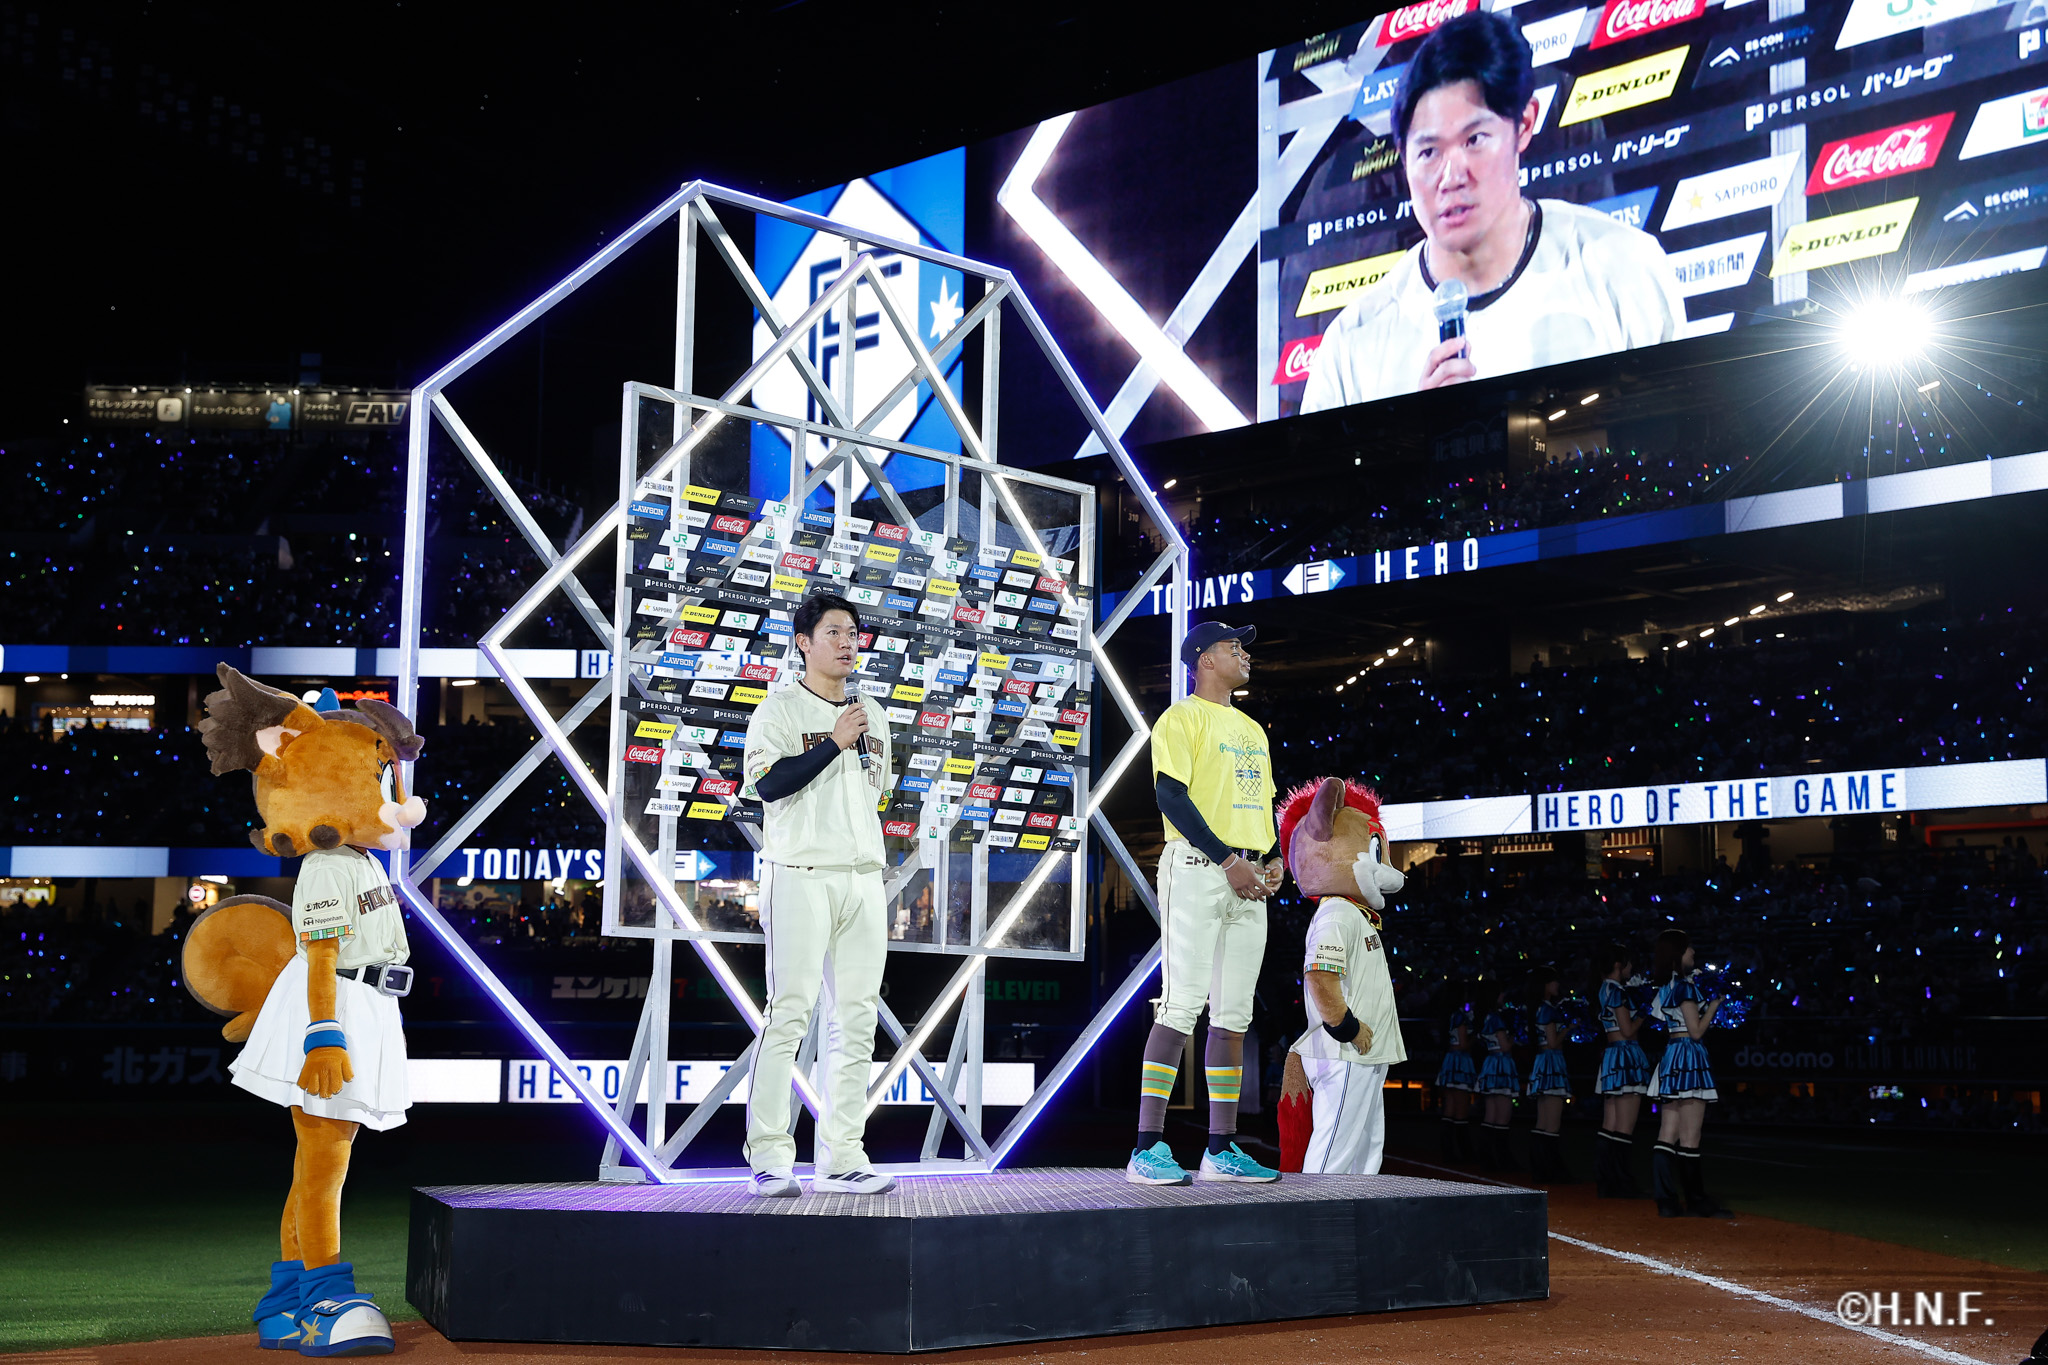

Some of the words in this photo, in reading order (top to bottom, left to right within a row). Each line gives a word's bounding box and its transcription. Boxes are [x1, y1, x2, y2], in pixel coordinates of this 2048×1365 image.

[1590, 68, 1671, 101] DUNLOP
[1767, 84, 1850, 118] PERSOL
[1822, 123, 1933, 185] Coca-Cola
[1531, 151, 1603, 182] PERSOL
[1715, 176, 1778, 203] SAPPORO
[1324, 207, 1387, 235] PERSOL
[1806, 221, 1898, 251] DUNLOP
[691, 492, 716, 500] DUNLOP
[632, 504, 664, 516] LAWSON
[773, 504, 787, 514] JR
[686, 515, 705, 523] SAPPORO
[804, 512, 832, 524] LAWSON
[716, 518, 746, 533] Coca-Cola
[878, 524, 905, 540] Coca-Cola
[921, 533, 933, 542] JR
[673, 533, 687, 544] JR
[706, 542, 736, 553] LAWSON
[756, 552, 774, 560] SAPPORO
[874, 550, 896, 558] DUNLOP
[785, 554, 811, 569] Coca-Cola
[946, 561, 958, 570] JR
[1375, 538, 1479, 584] HERO
[974, 568, 998, 578] LAWSON
[651, 580, 675, 589] PERSOL
[1040, 579, 1062, 593] Coca-Cola
[725, 592, 747, 601] PERSOL
[859, 590, 871, 600] JR
[1005, 594, 1017, 603] JR
[888, 598, 914, 608] LAWSON
[1032, 601, 1055, 611] LAWSON
[653, 606, 672, 614] SAPPORO
[957, 608, 981, 622] Coca-Cola
[734, 614, 746, 624] JR
[764, 622, 792, 633] LAWSON
[922, 624, 941, 632] PERSOL
[674, 631, 704, 645] Coca-Cola
[1039, 644, 1057, 652] PERSOL
[663, 656, 694, 667] LAWSON
[744, 666, 773, 680] Coca-Cola
[912, 666, 924, 676] JR
[1054, 665, 1064, 674] JR
[938, 670, 964, 682] LAWSON
[1006, 681, 1030, 694] Coca-Cola
[647, 702, 671, 710] PERSOL
[971, 698, 983, 708] JR
[998, 704, 1023, 713] LAWSON
[720, 711, 742, 719] PERSOL
[922, 713, 947, 727] Coca-Cola
[1062, 711, 1085, 724] Coca-Cola
[691, 729, 705, 738] JR
[918, 736, 938, 744] PERSOL
[629, 747, 660, 762] Coca-Cola
[1021, 769, 1032, 778] JR
[1047, 773, 1070, 782] LAWSON
[703, 780, 732, 794] Coca-Cola
[904, 780, 929, 789] LAWSON
[972, 785, 997, 798] Coca-Cola
[1544, 793, 1625, 828] HERO
[1646, 787, 1682, 824] OF
[1704, 781, 1770, 821] THE
[1795, 772, 1898, 814] GAME
[936, 804, 948, 813] JR
[964, 810, 989, 818] LAWSON
[1031, 815, 1053, 827] Coca-Cola
[886, 822, 910, 836] Coca-Cola
[1185, 855, 1209, 867] ニトリ
[312, 899, 339, 910] ホクレン
[315, 914, 344, 924] Nipponham
[1734, 1044, 1834, 1069] docomo
